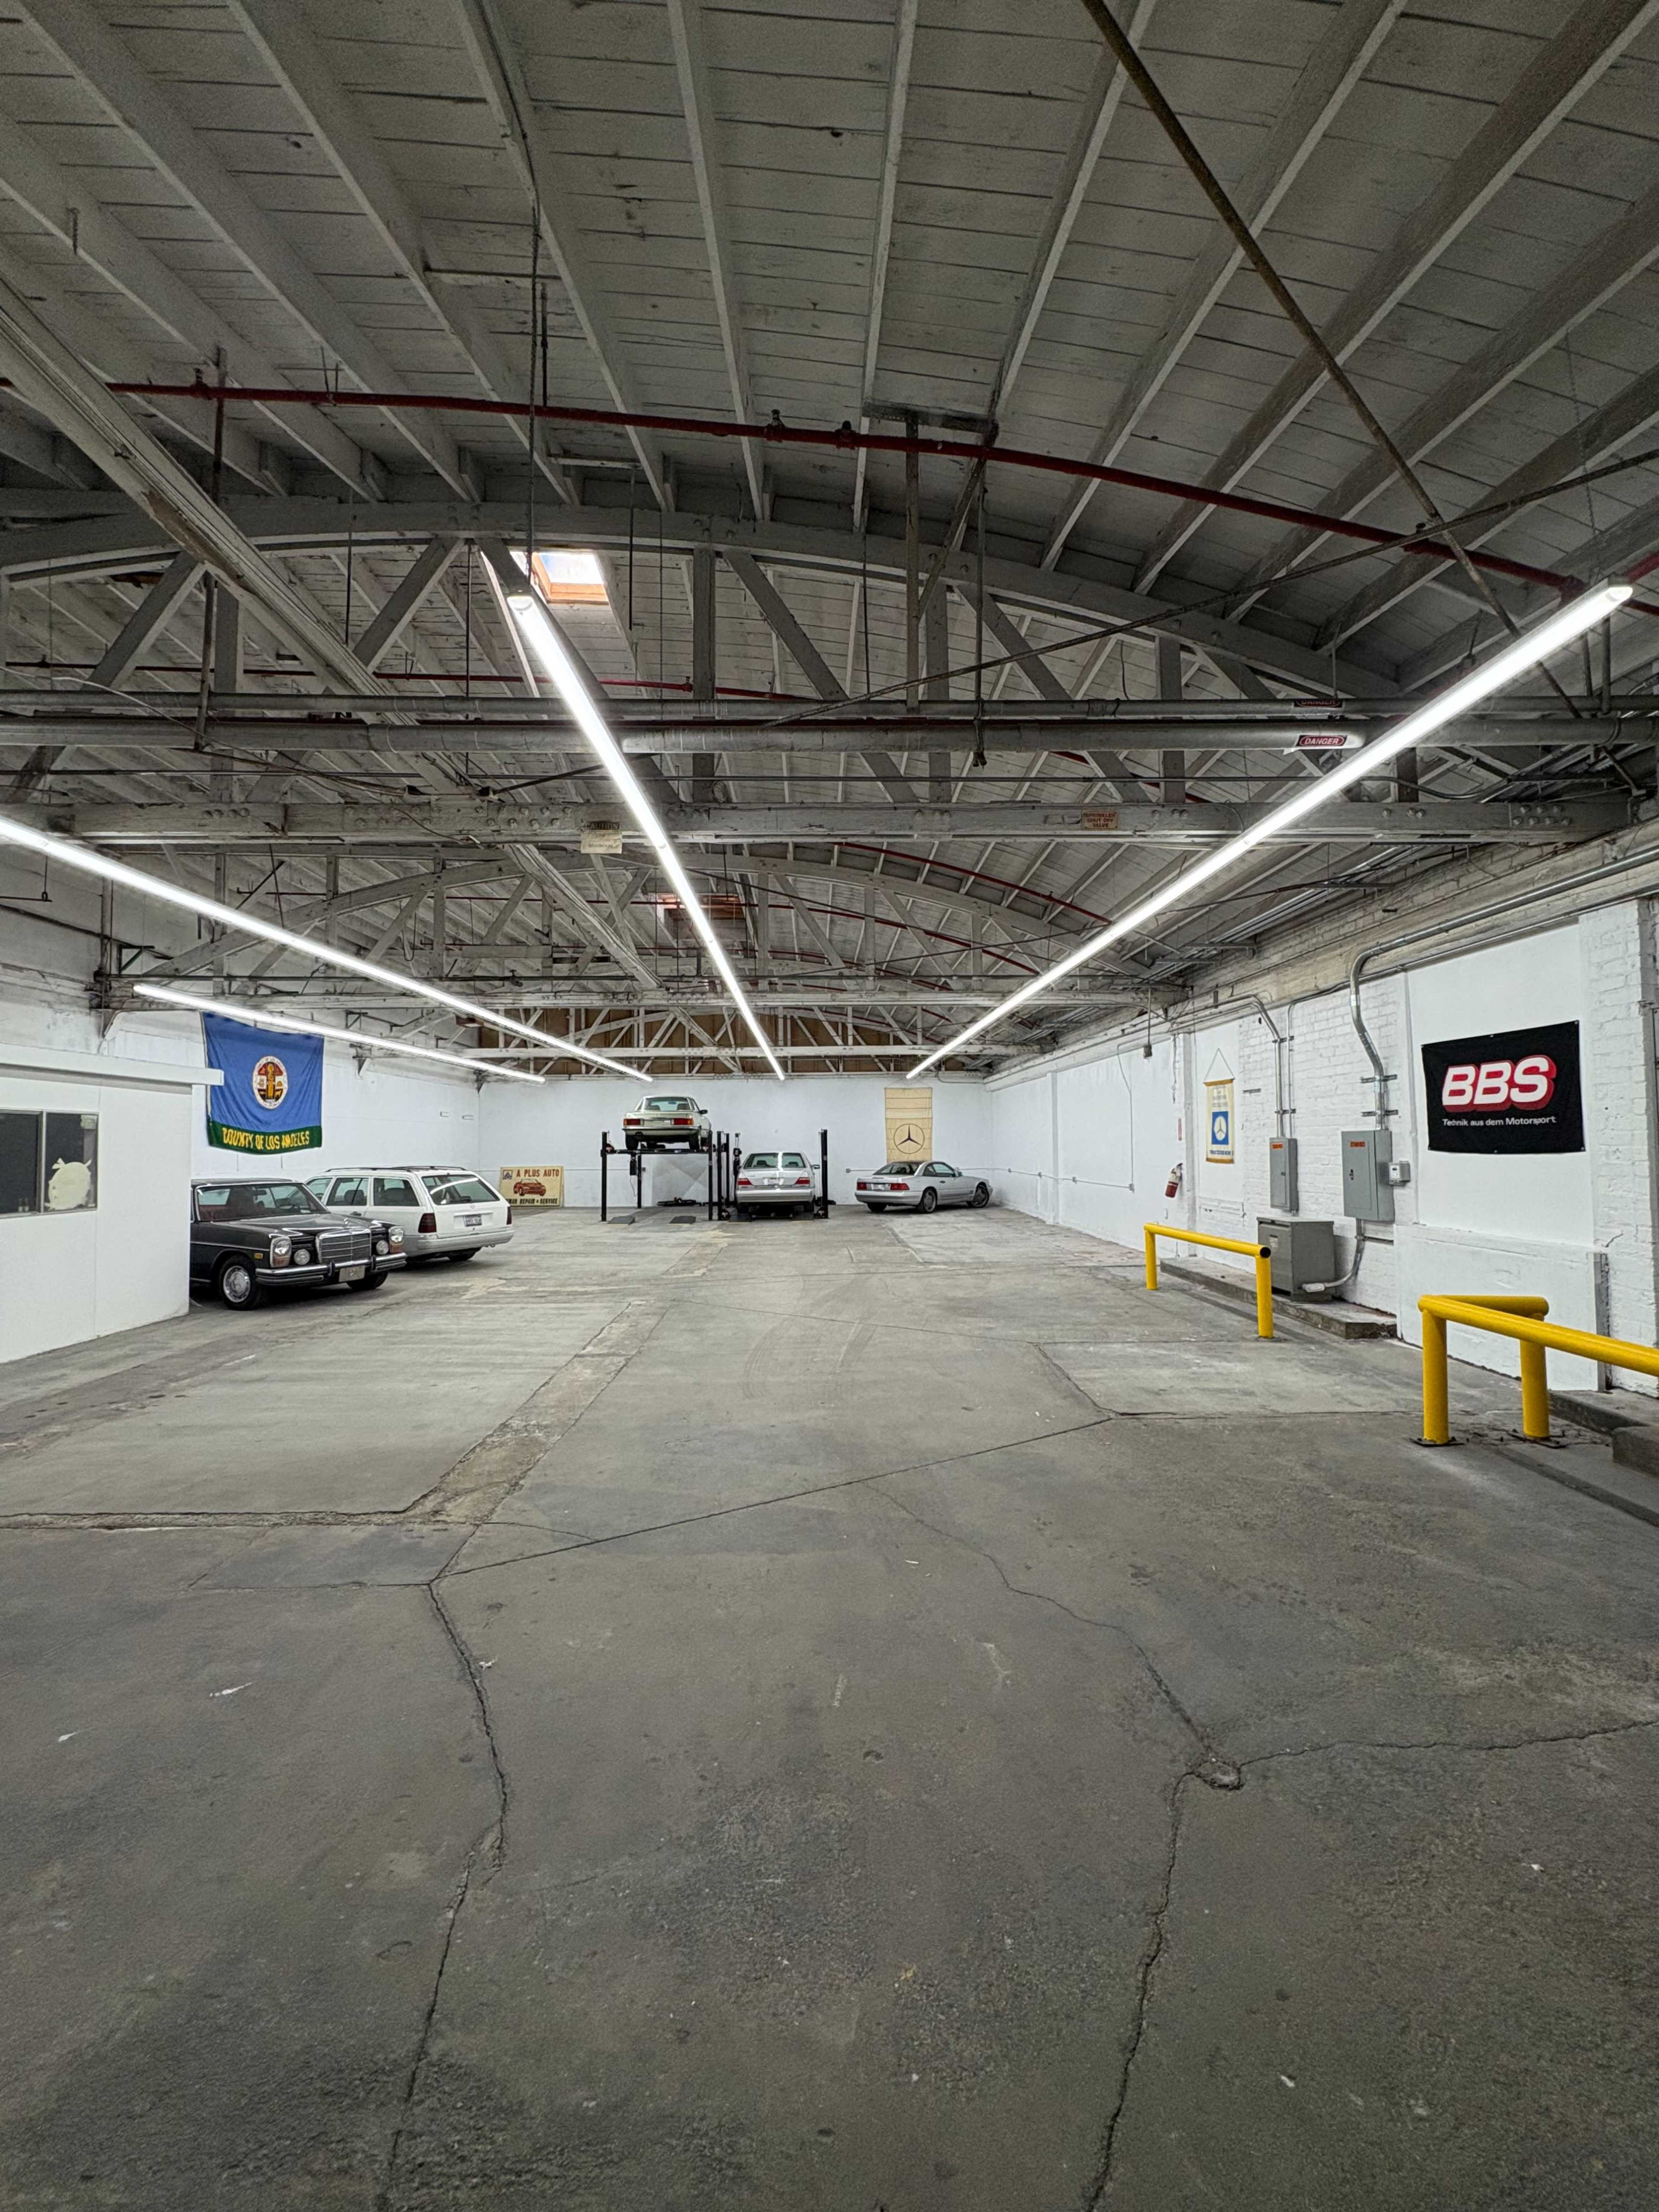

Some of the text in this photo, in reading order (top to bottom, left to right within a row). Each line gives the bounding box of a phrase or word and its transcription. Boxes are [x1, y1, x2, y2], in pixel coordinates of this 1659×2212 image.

[1442, 1055, 1556, 1112] BBS
[1505, 1116, 1557, 1126] Motorsport
[222, 1128, 310, 1150] COUNTY OF LOS ANGELES
[524, 1169, 540, 1177] PLUS
[543, 1169, 559, 1177] AUTO
